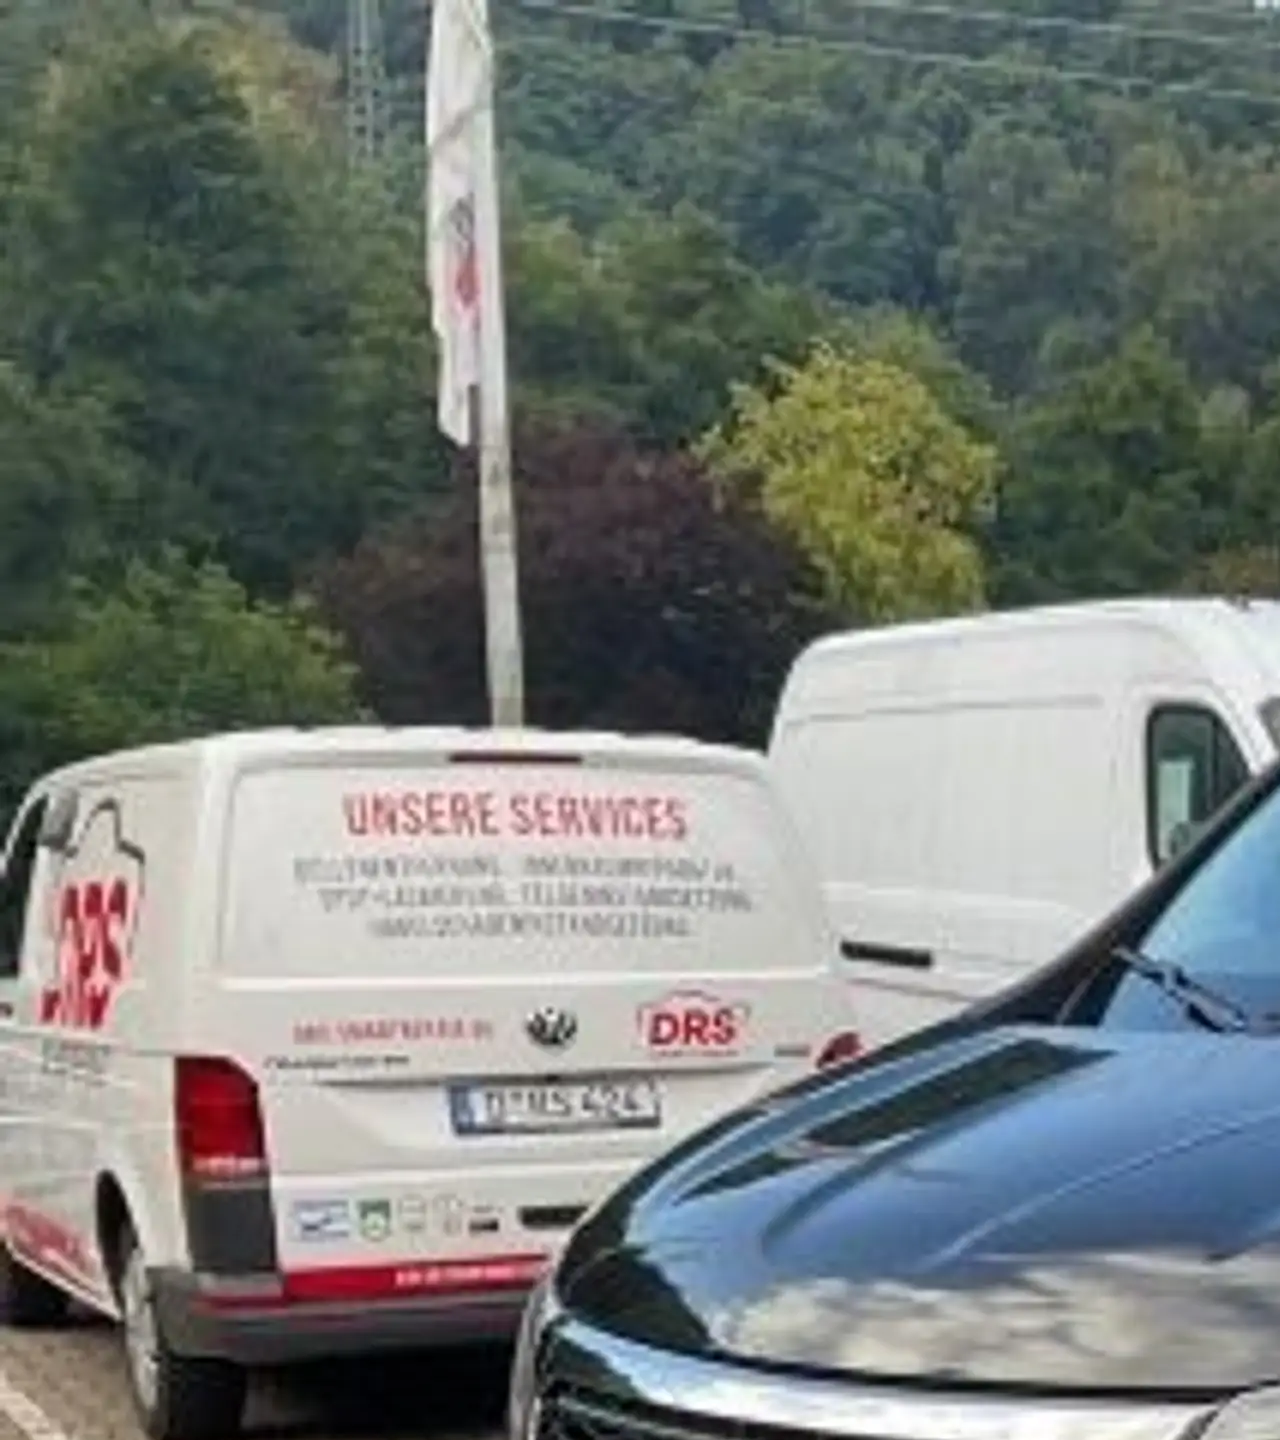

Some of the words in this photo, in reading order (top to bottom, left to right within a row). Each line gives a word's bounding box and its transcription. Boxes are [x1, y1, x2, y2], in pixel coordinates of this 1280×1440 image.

[343, 791, 500, 837] UNSERE
[508, 795, 687, 841] SERVICES
[649, 1006, 737, 1046] DRS
